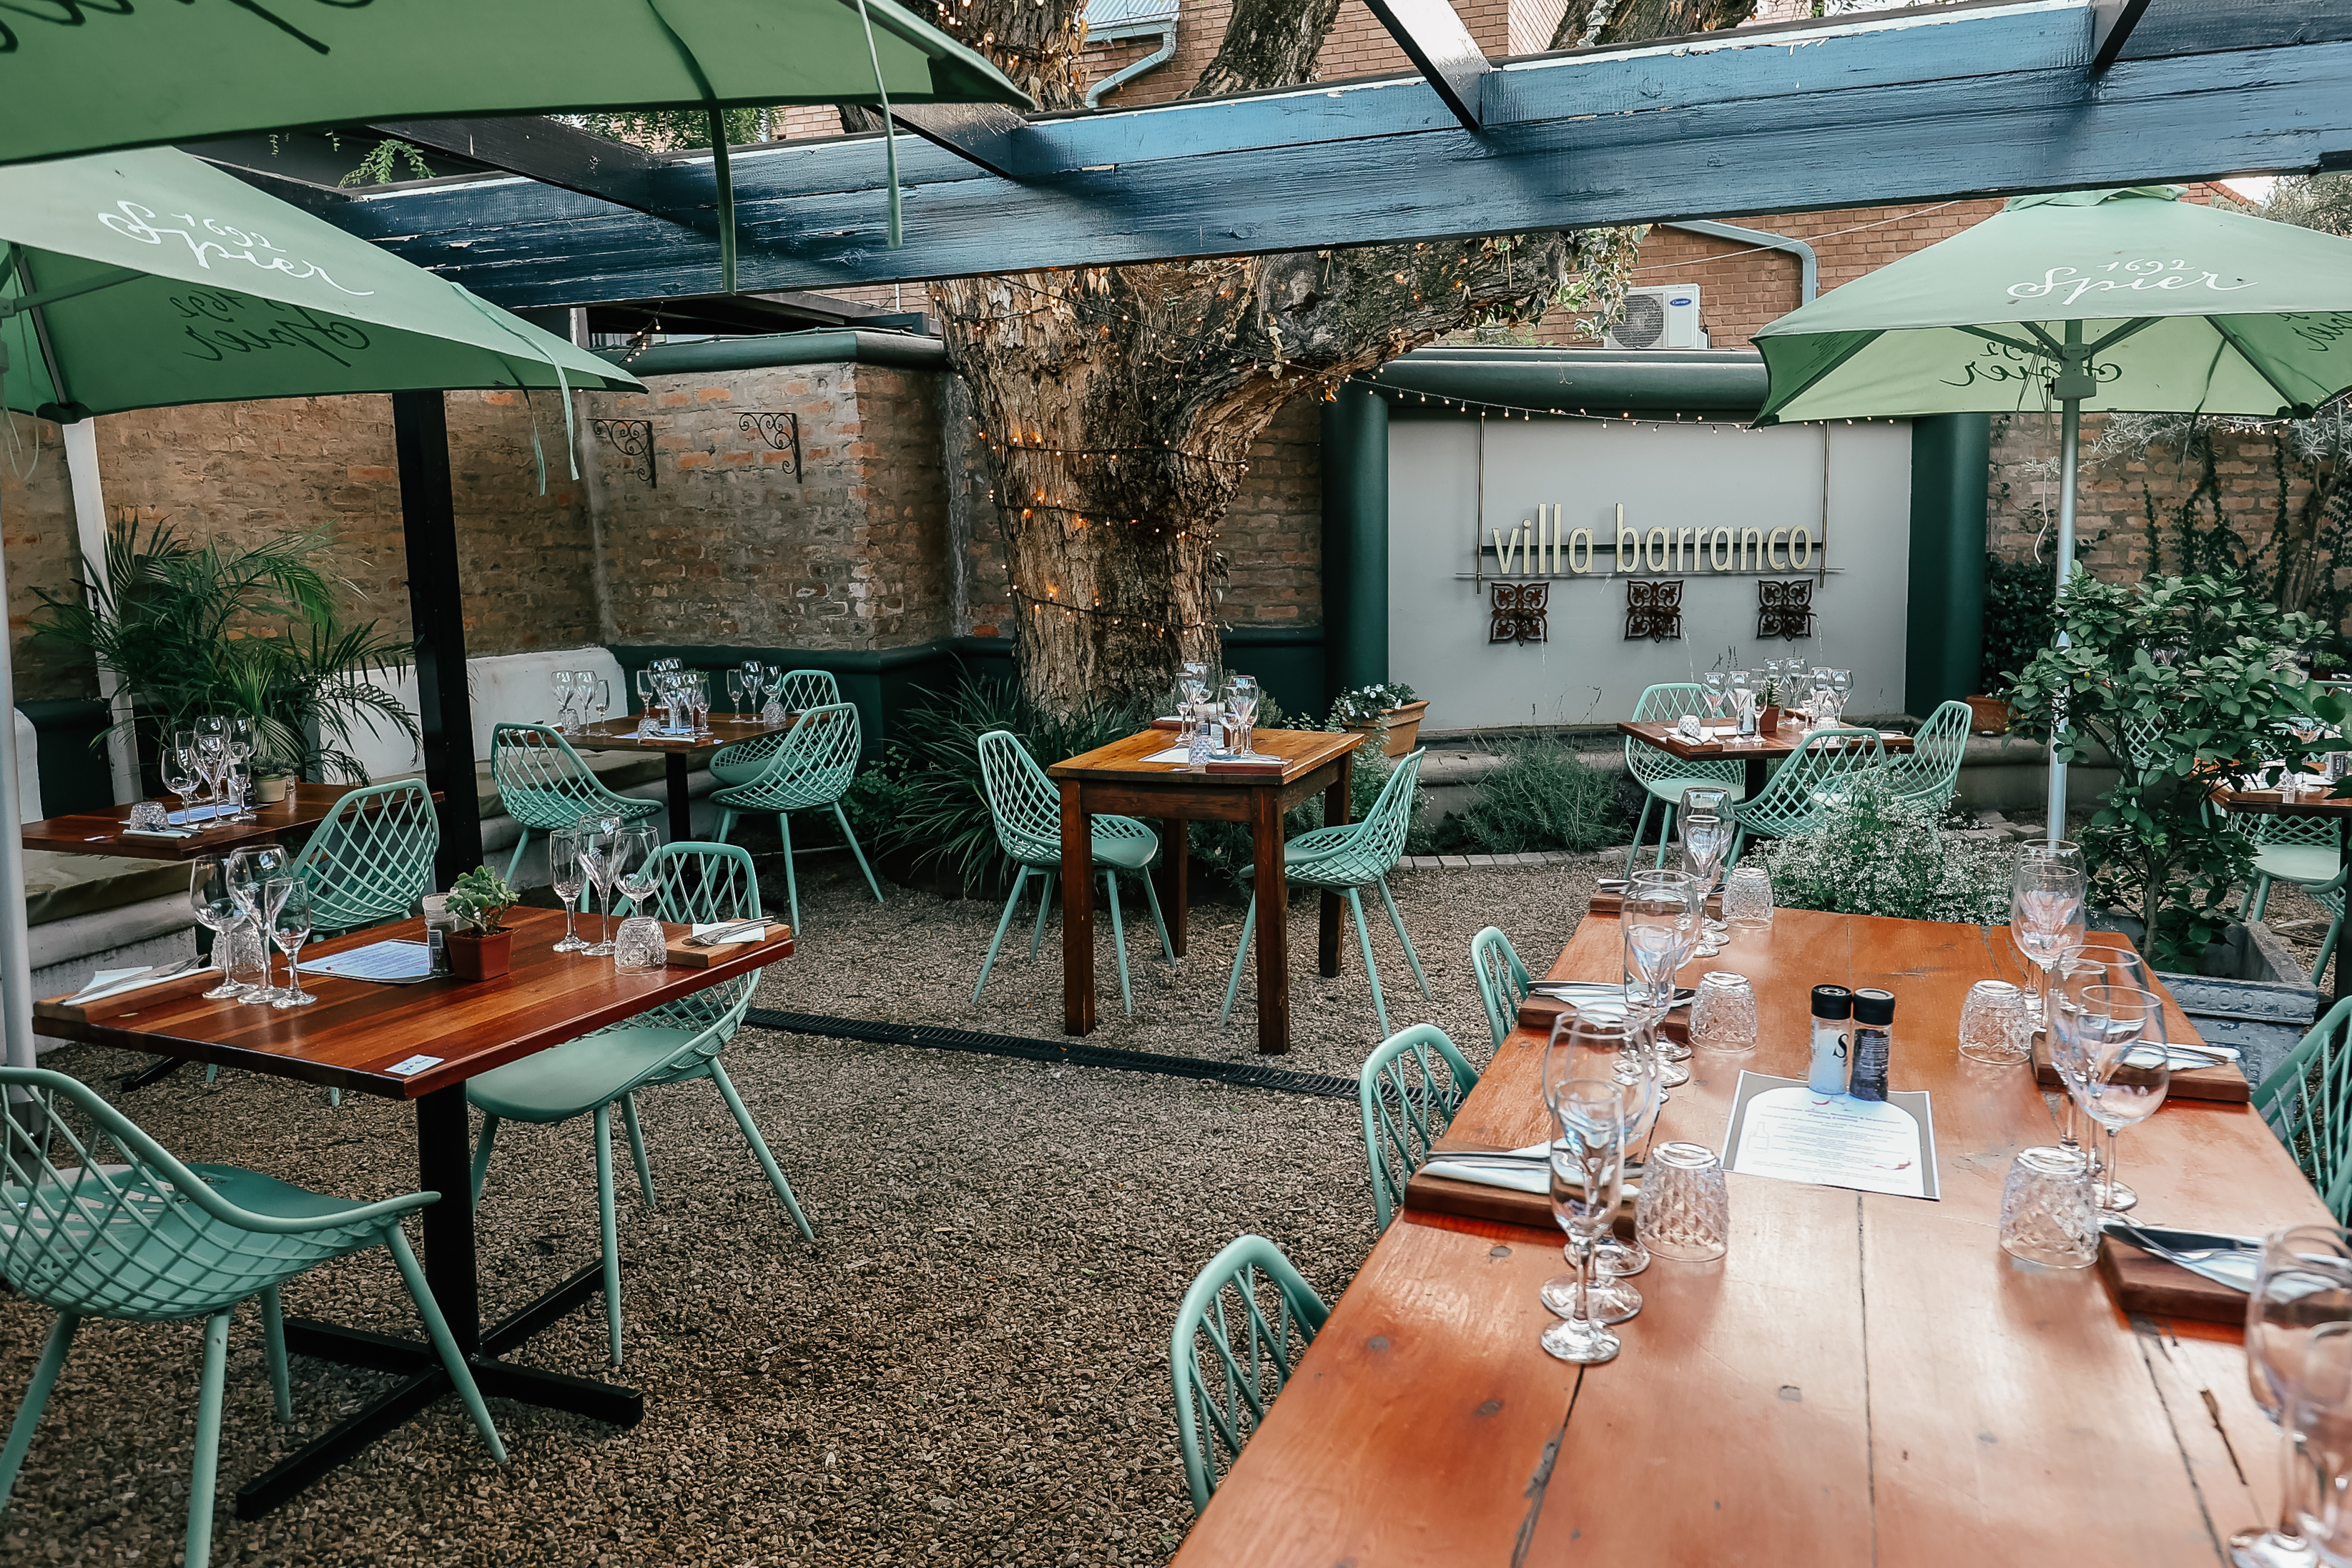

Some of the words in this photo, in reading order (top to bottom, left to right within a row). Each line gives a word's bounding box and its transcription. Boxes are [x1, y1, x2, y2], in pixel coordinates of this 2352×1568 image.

[97, 199, 375, 296] Spier
[171, 212, 287, 253] 1692
[2006, 266, 2258, 305] Spier
[2096, 258, 2195, 275] 1692
[1491, 503, 1593, 574] villa
[1614, 502, 1813, 573] barranco
[1832, 1033, 1849, 1059] S
